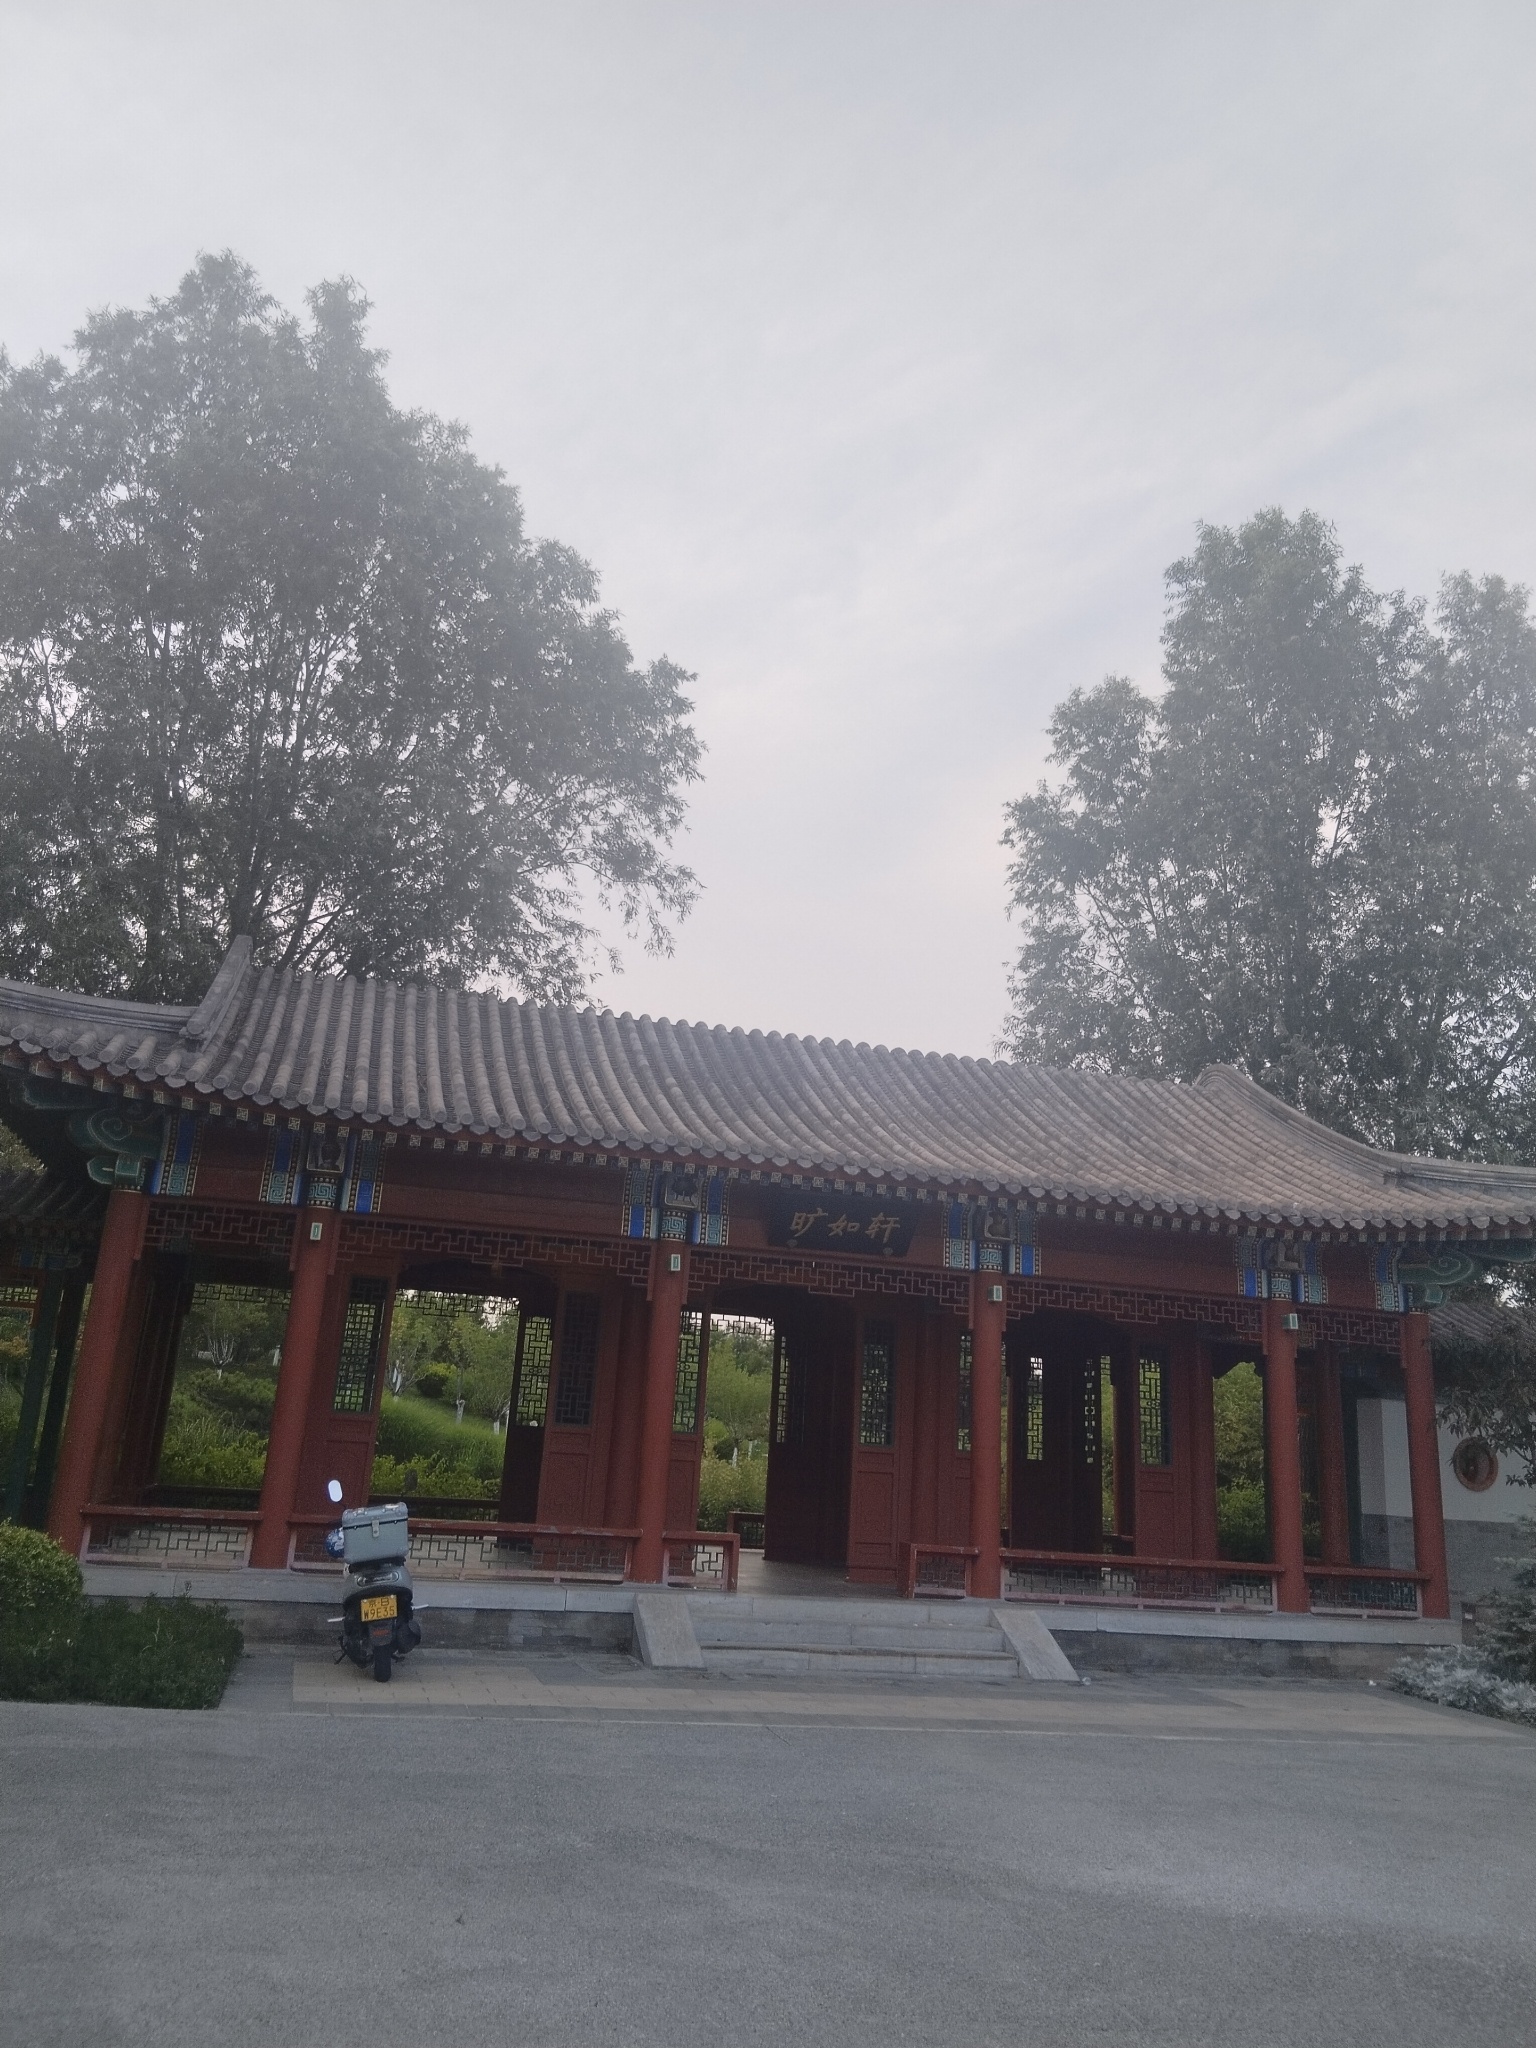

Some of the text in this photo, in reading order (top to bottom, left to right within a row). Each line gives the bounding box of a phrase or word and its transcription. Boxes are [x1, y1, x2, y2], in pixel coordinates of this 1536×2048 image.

[790, 1207, 900, 1243] 旷如轩
[363, 1605, 395, 1619] W9E35
